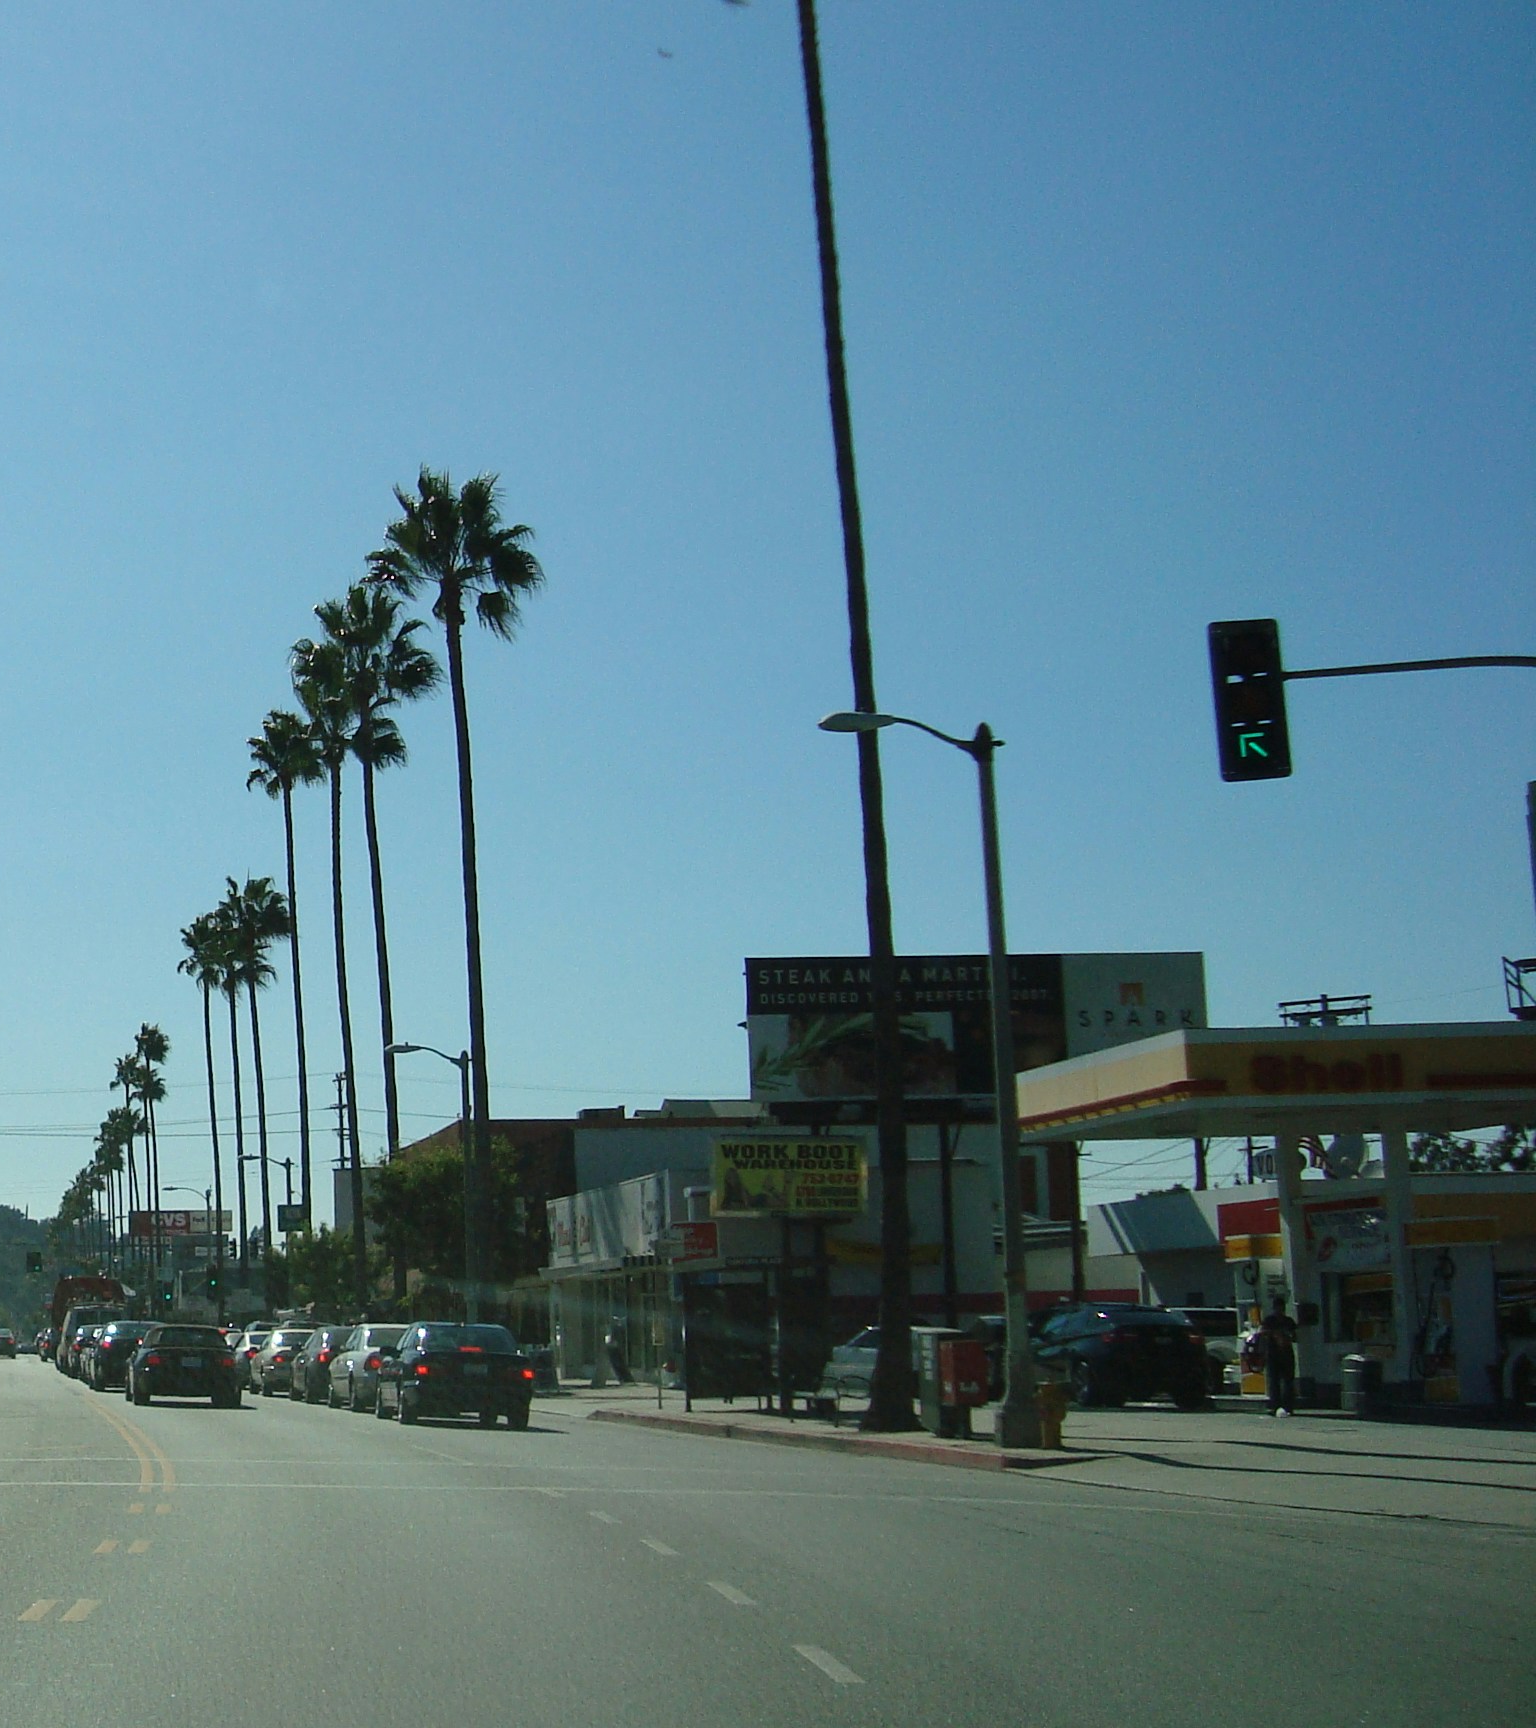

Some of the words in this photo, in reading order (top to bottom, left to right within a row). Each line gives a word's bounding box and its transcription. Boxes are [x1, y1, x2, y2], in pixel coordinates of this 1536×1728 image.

[758, 968, 831, 986] STEAK
[842, 967, 872, 984] AN
[897, 966, 912, 984] A
[759, 991, 859, 1005] DISCOVERED
[1077, 1009, 1194, 1028] SPARK
[1251, 1053, 1403, 1091] Shell
[721, 1144, 789, 1159] WORK
[797, 1144, 857, 1159] BOOT
[733, 1158, 857, 1170] WAREHOUSE
[150, 1212, 186, 1227] CVS
